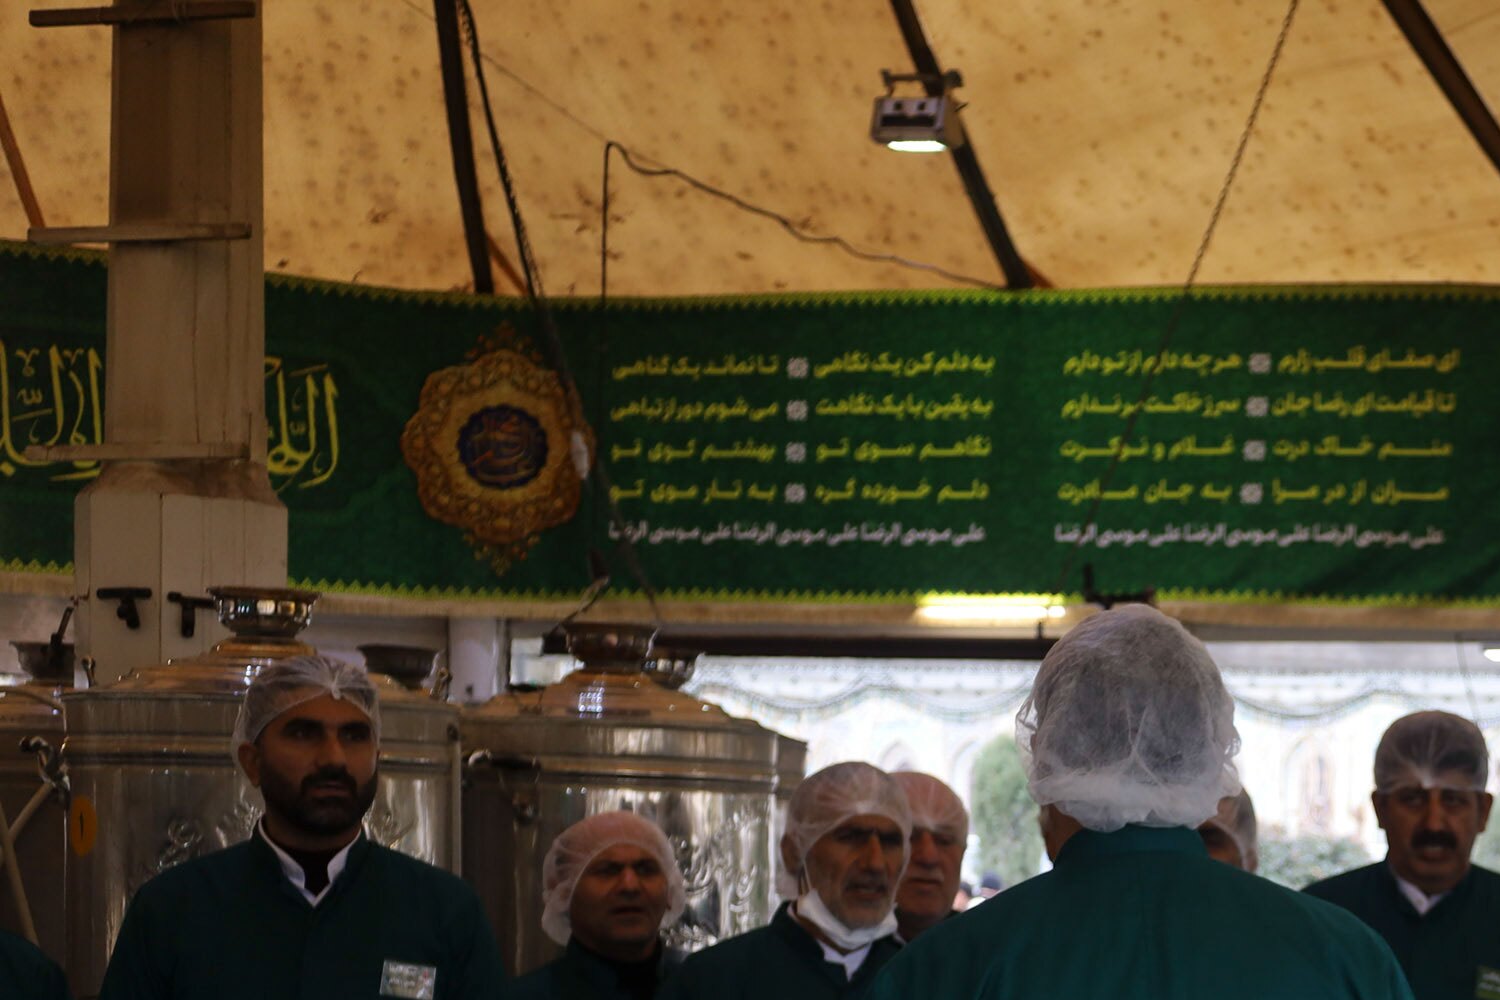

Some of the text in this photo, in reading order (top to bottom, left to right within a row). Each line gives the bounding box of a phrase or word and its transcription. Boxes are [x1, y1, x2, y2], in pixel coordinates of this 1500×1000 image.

[813, 350, 870, 379] نگاهی
[934, 350, 970, 377] دلم
[971, 354, 996, 377] به
[1063, 349, 1101, 376] دارم
[1125, 349, 1143, 376] از
[1141, 350, 1180, 376] دارم
[1311, 345, 1366, 374] قلب
[1365, 348, 1437, 373] صفای
[1435, 348, 1460, 373] ای
[1271, 391, 1313, 418] جان
[1313, 391, 1351, 419] رضا
[1374, 388, 1437, 418] قیامت
[611, 437, 642, 463] تو
[701, 436, 776, 462] بهشتم
[815, 436, 850, 463] تو
[853, 440, 916, 463] سوی
[919, 434, 993, 462] نگاهم
[1060, 434, 1453, 462] منم خاک درت غلام و نوکرت
[609, 475, 990, 505] دلم خورده گره به تار موی تو
[1057, 478, 1449, 506] مران از در مرا به جان مادرت
[649, 526, 700, 545] موسی
[701, 521, 733, 545] علی
[733, 520, 777, 545] الرضا
[775, 527, 828, 547] موسی
[826, 522, 859, 547] علی
[859, 521, 902, 547] الرضا
[900, 527, 953, 547] موسی
[951, 522, 986, 547] علی
[1053, 522, 1446, 549] علی موسی الرضا علی موسی الرضا علی موسی الرضا
